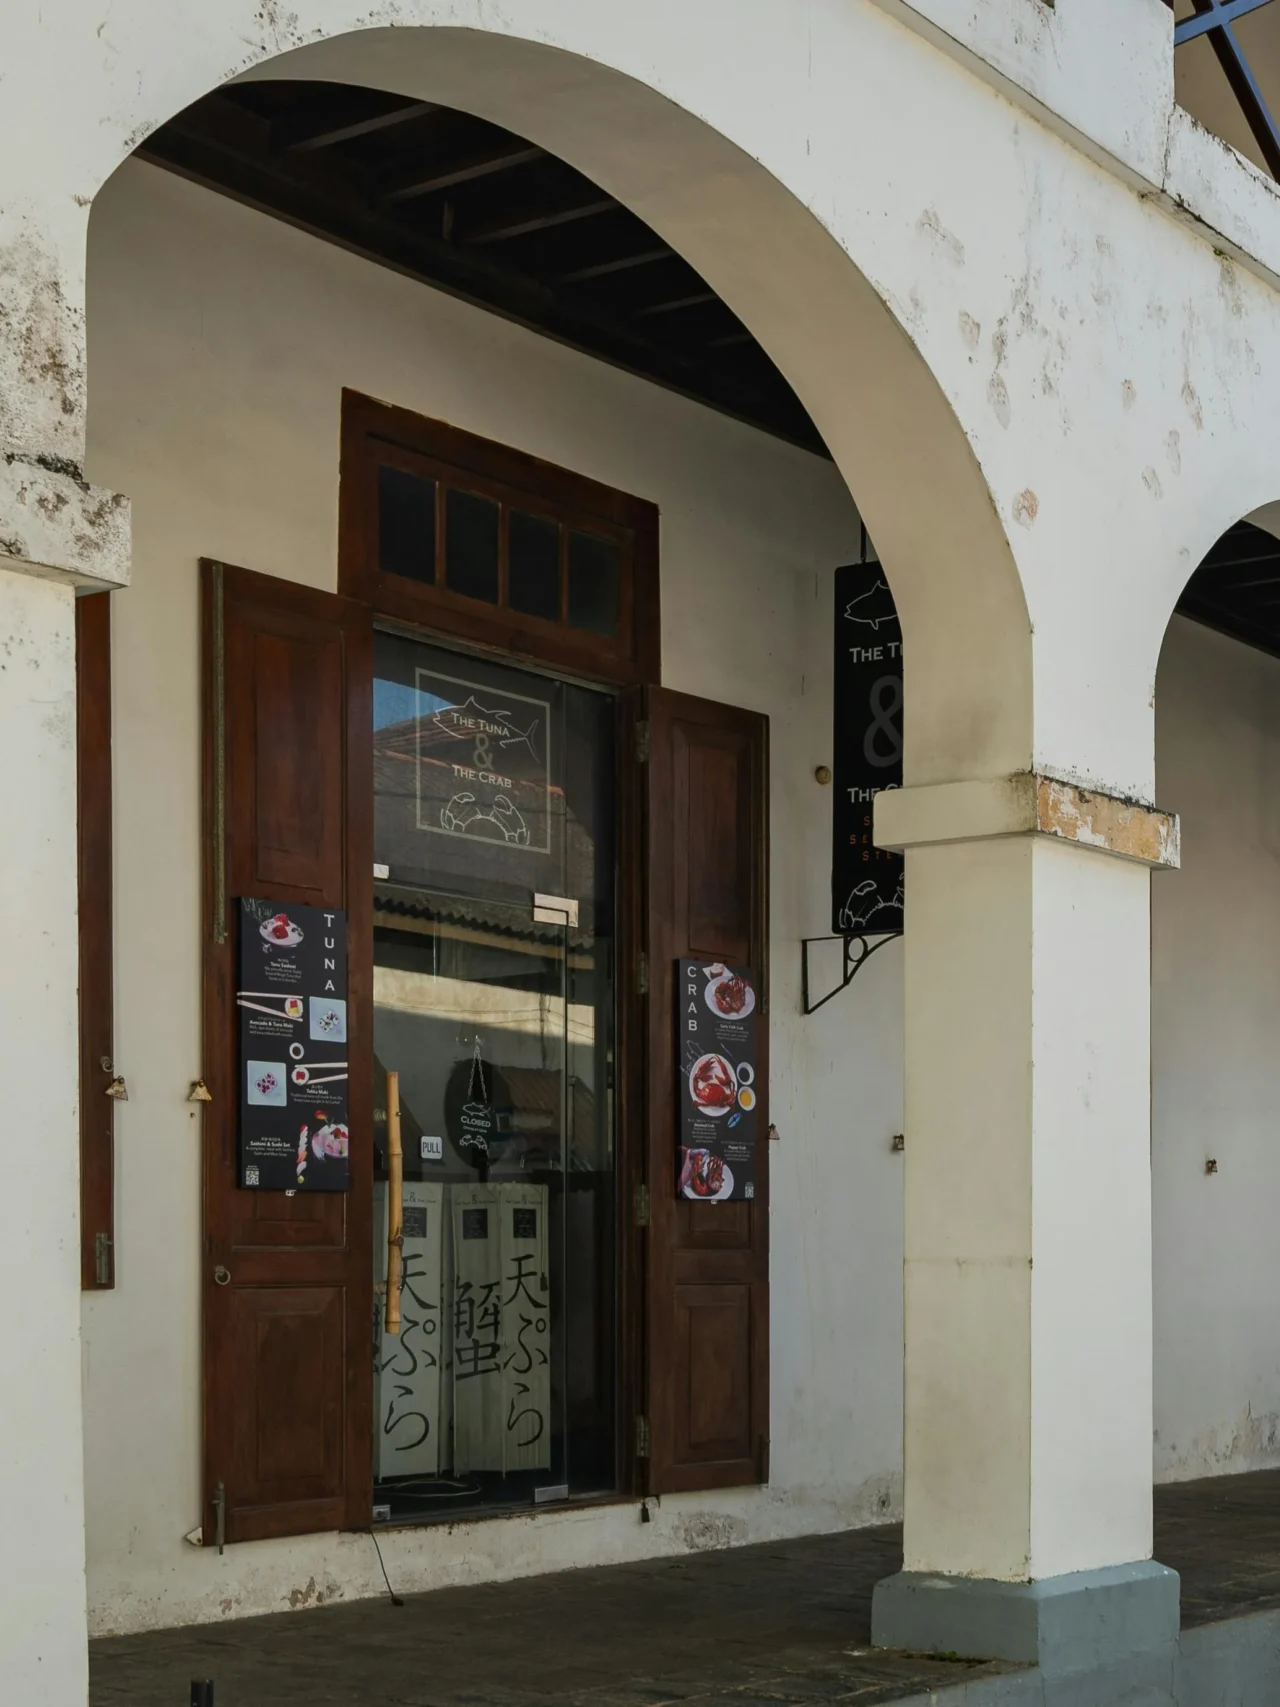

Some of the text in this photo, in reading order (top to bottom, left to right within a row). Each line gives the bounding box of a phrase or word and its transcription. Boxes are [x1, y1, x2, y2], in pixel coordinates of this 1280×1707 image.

[849, 641, 904, 663] THE T
[451, 712, 510, 738] THE TUNA
[473, 733, 494, 771] &
[452, 764, 512, 789] THE CRAB
[323, 913, 335, 993] TUNA
[687, 966, 698, 1031] CRAB
[461, 1115, 491, 1128] CLOSED
[422, 1141, 441, 1154] PULL
[502, 1253, 549, 1448] 天ぷら
